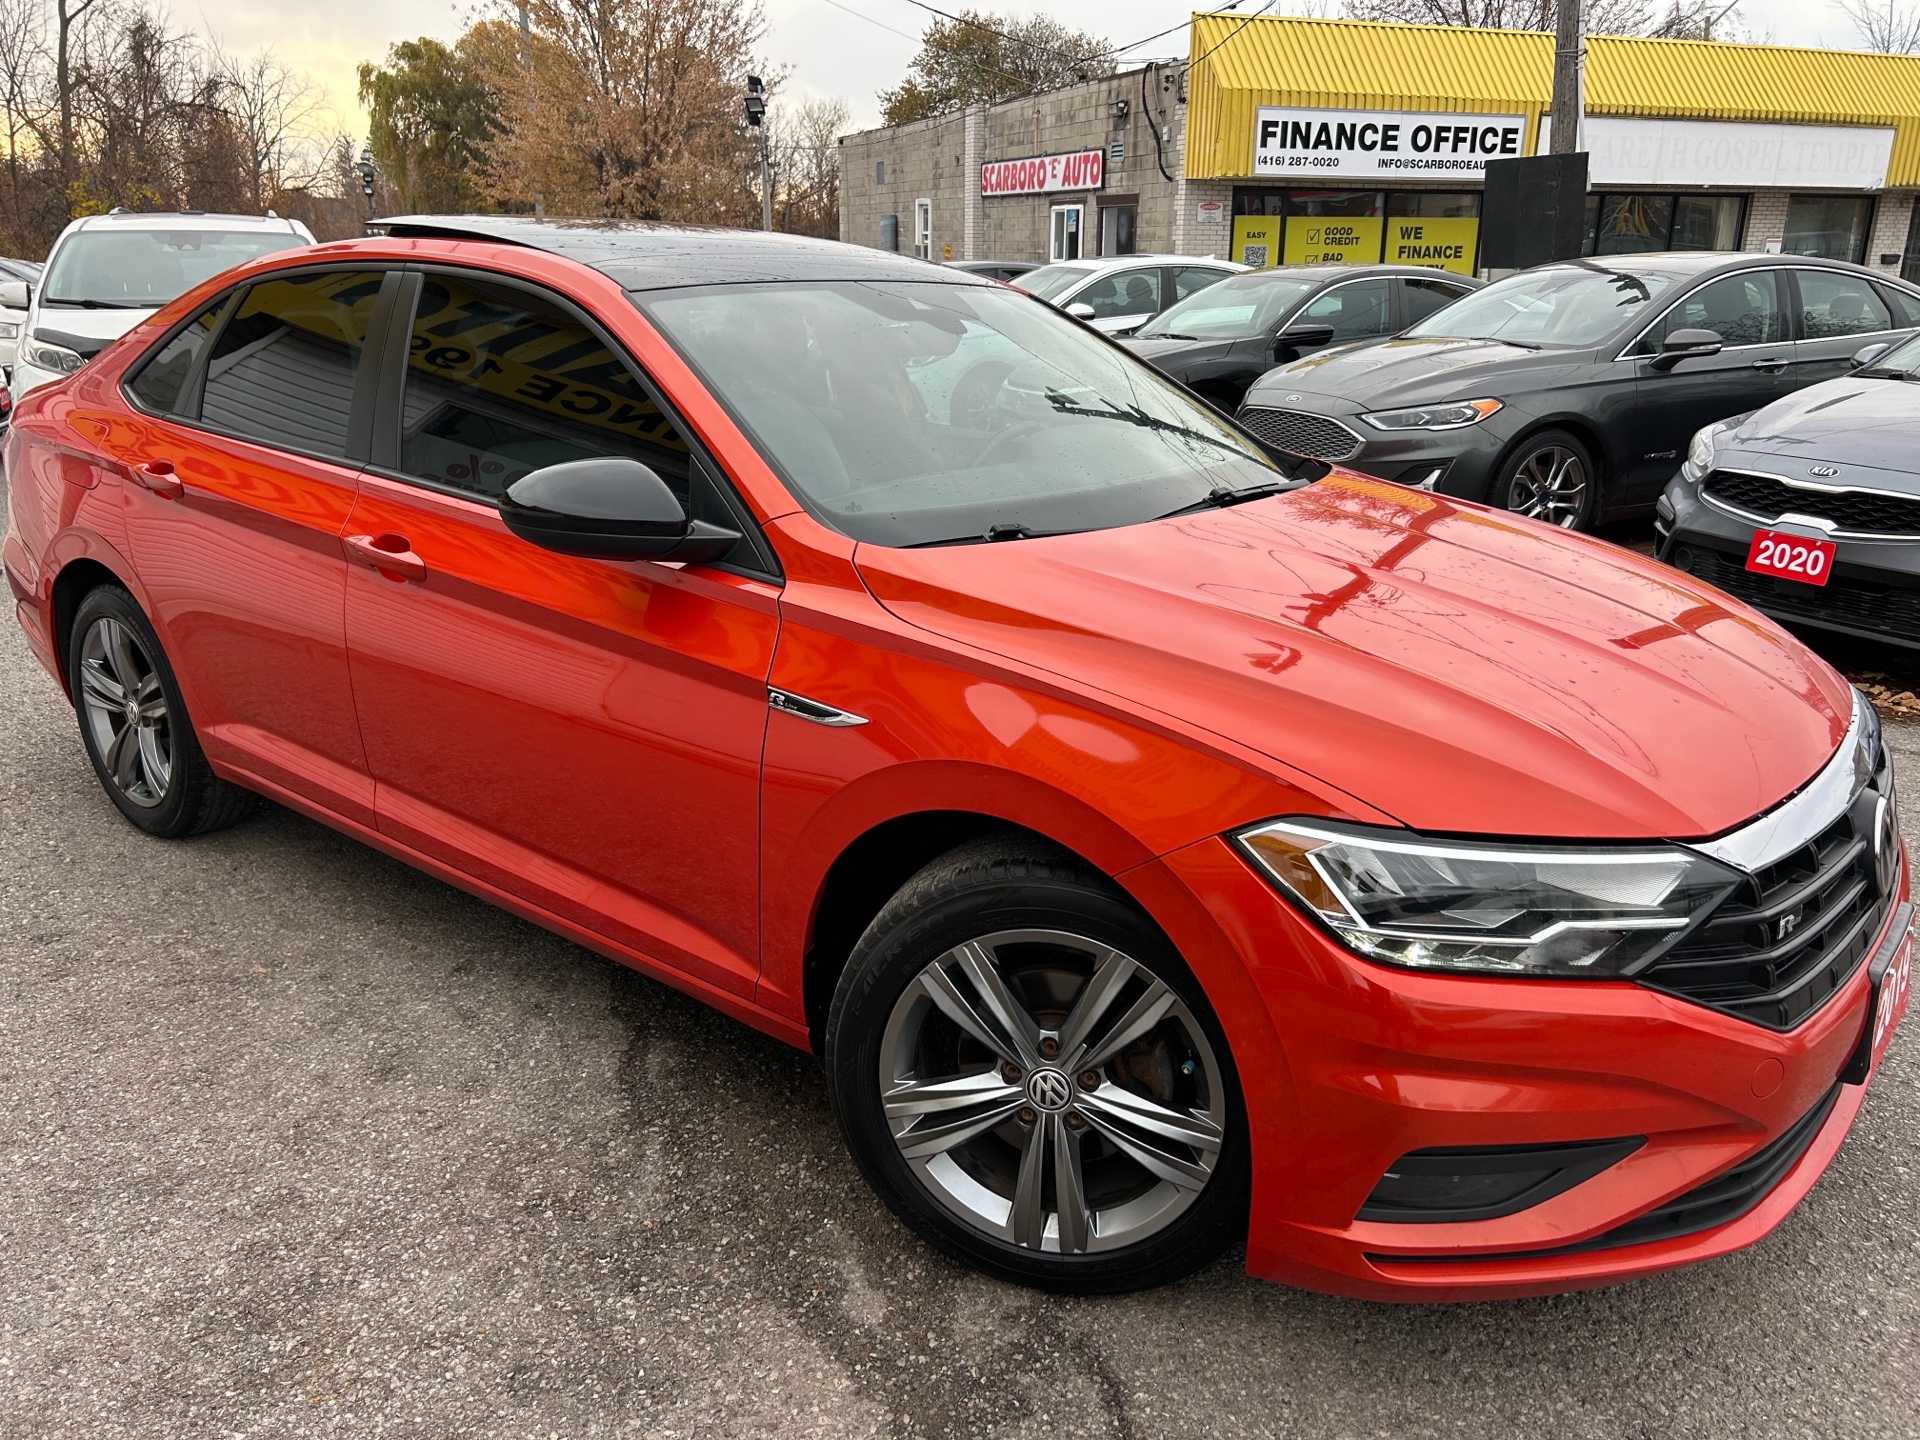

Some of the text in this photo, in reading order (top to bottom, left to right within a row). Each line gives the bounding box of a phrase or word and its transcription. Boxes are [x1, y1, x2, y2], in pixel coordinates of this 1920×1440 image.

[1260, 119, 1519, 154] FINANCE OFFICE
[1258, 155, 1285, 167] (416)
[1288, 156, 1340, 168] 287-0020
[1694, 137, 1790, 172] GOSPEL
[1795, 141, 1887, 174] TEMPLE
[981, 158, 1047, 193] SCARBORO
[1061, 152, 1101, 187] AUTO
[1246, 231, 1267, 239] EASY
[1324, 226, 1353, 236] GOOD
[1400, 226, 1423, 240] WE
[1323, 236, 1360, 246] CREDIT
[1322, 252, 1344, 262] BAD
[1398, 245, 1463, 259] FINANCE
[1810, 466, 1836, 476] KIA
[1755, 539, 1825, 576] 2020
[768, 692, 785, 706] R
[1874, 940, 1911, 1049] 2019
